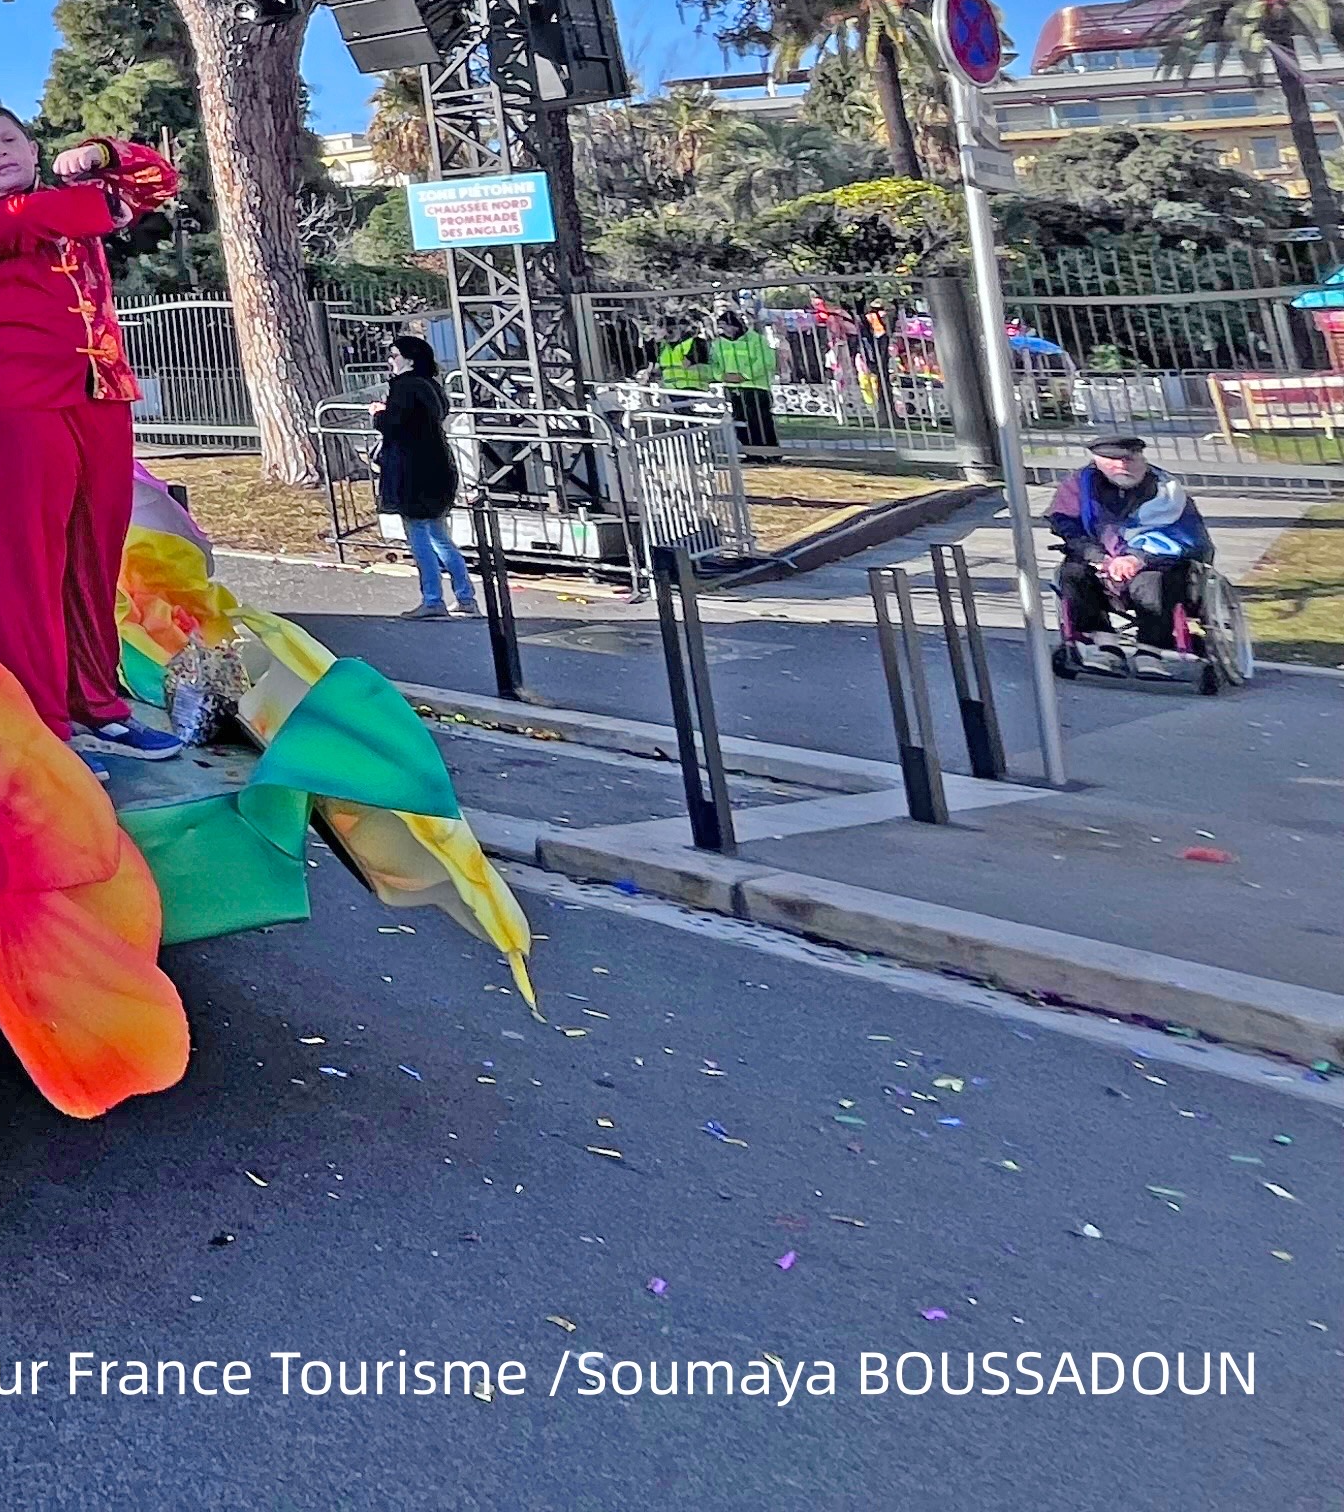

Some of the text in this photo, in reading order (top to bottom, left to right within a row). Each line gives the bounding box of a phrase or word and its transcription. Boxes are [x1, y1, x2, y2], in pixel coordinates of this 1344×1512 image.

[417, 181, 536, 202] ZONE PIÉTONNE
[492, 199, 529, 210] NORD
[440, 212, 518, 225] PROMENADE
[441, 224, 521, 238] DES ANGLAIS
